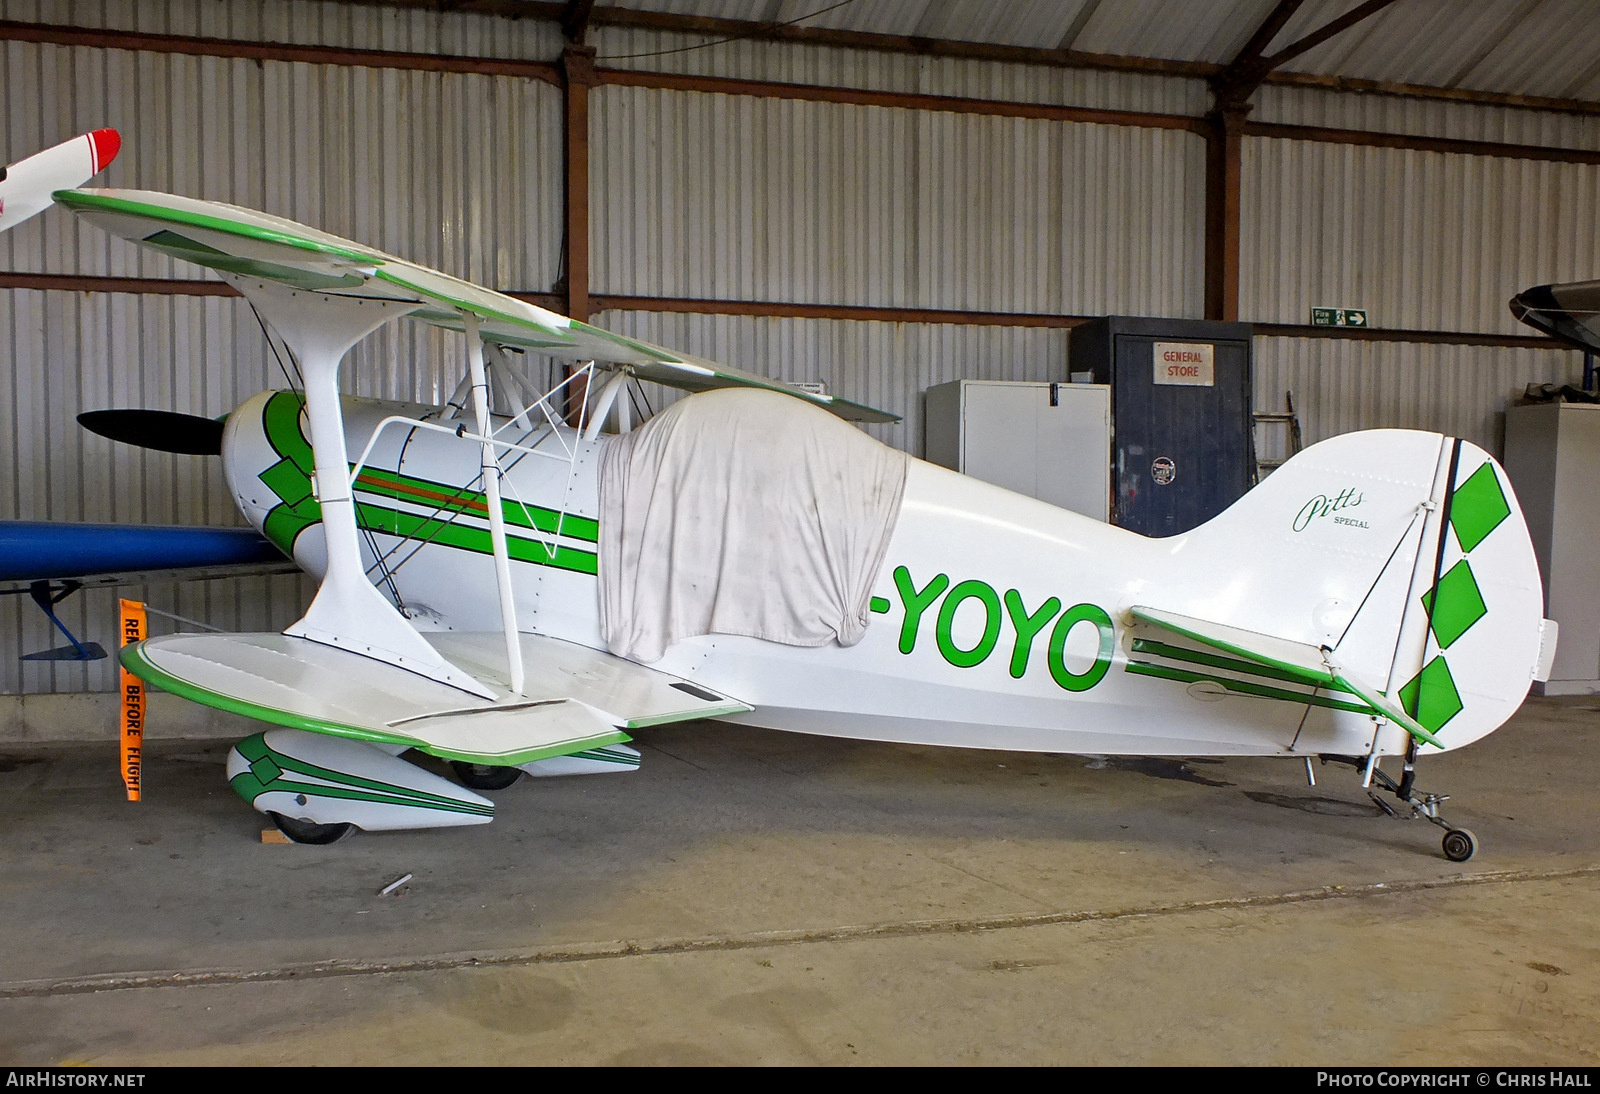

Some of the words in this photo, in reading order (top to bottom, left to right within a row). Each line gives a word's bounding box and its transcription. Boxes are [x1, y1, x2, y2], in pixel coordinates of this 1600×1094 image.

[1315, 310, 1330, 318] Fire
[1163, 351, 1203, 363] GENERAL
[1167, 365, 1199, 377] STORE
[1292, 487, 1366, 533] Pitts
[1334, 516, 1370, 529] SPECIAL
[126, 685, 141, 737] BEFORE
